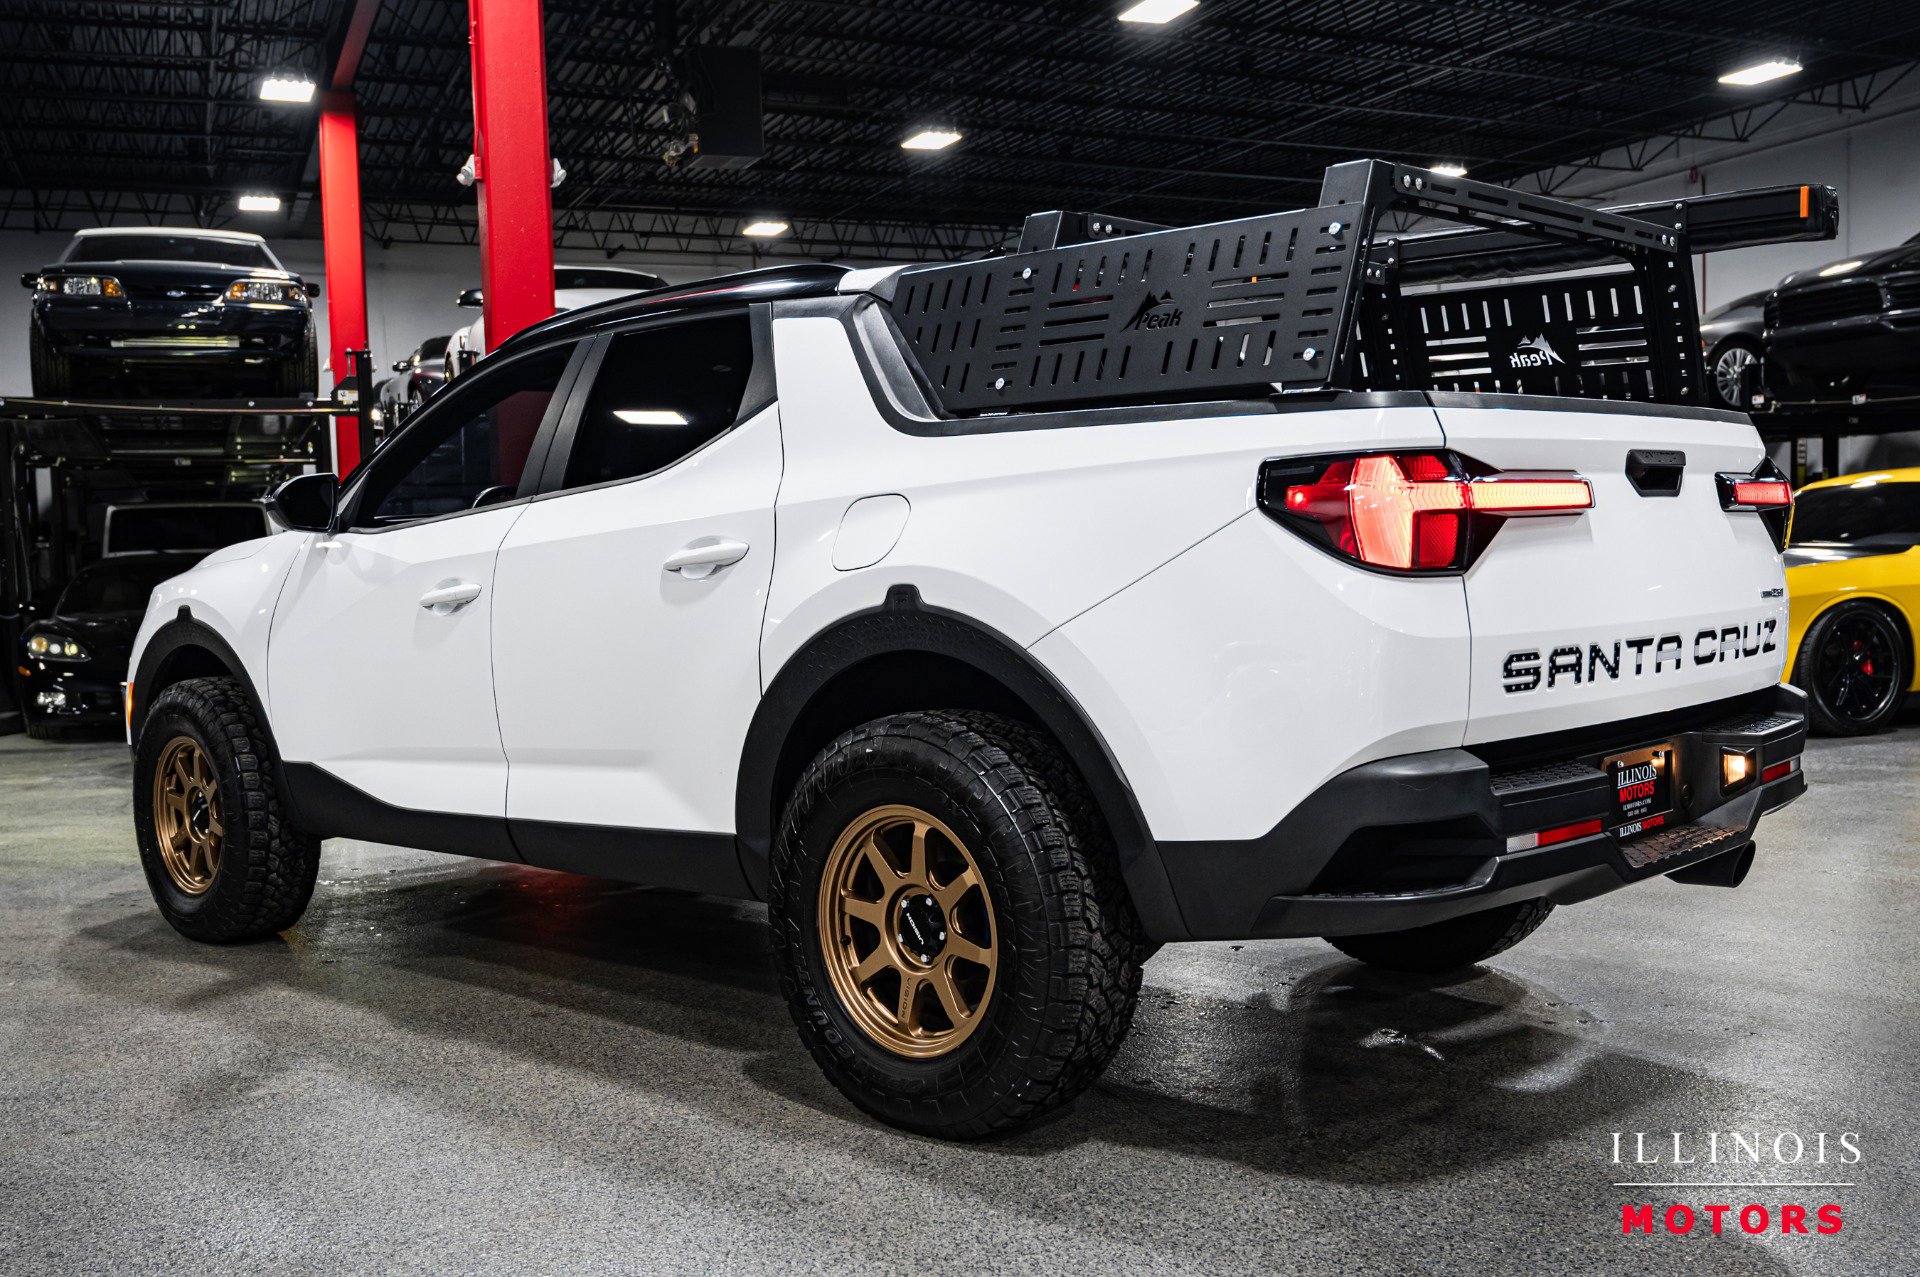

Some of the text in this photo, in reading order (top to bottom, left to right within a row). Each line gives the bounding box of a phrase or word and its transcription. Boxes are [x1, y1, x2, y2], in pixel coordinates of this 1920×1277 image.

[1502, 618, 1777, 694] SANTA CRUZ
[1617, 764, 1657, 787] ILLINOIS
[1619, 780, 1655, 803] MOTORS
[1620, 815, 1665, 837] ILLINOIS MOTORS
[906, 912, 924, 945] VISION
[901, 977, 911, 1018] VISION
